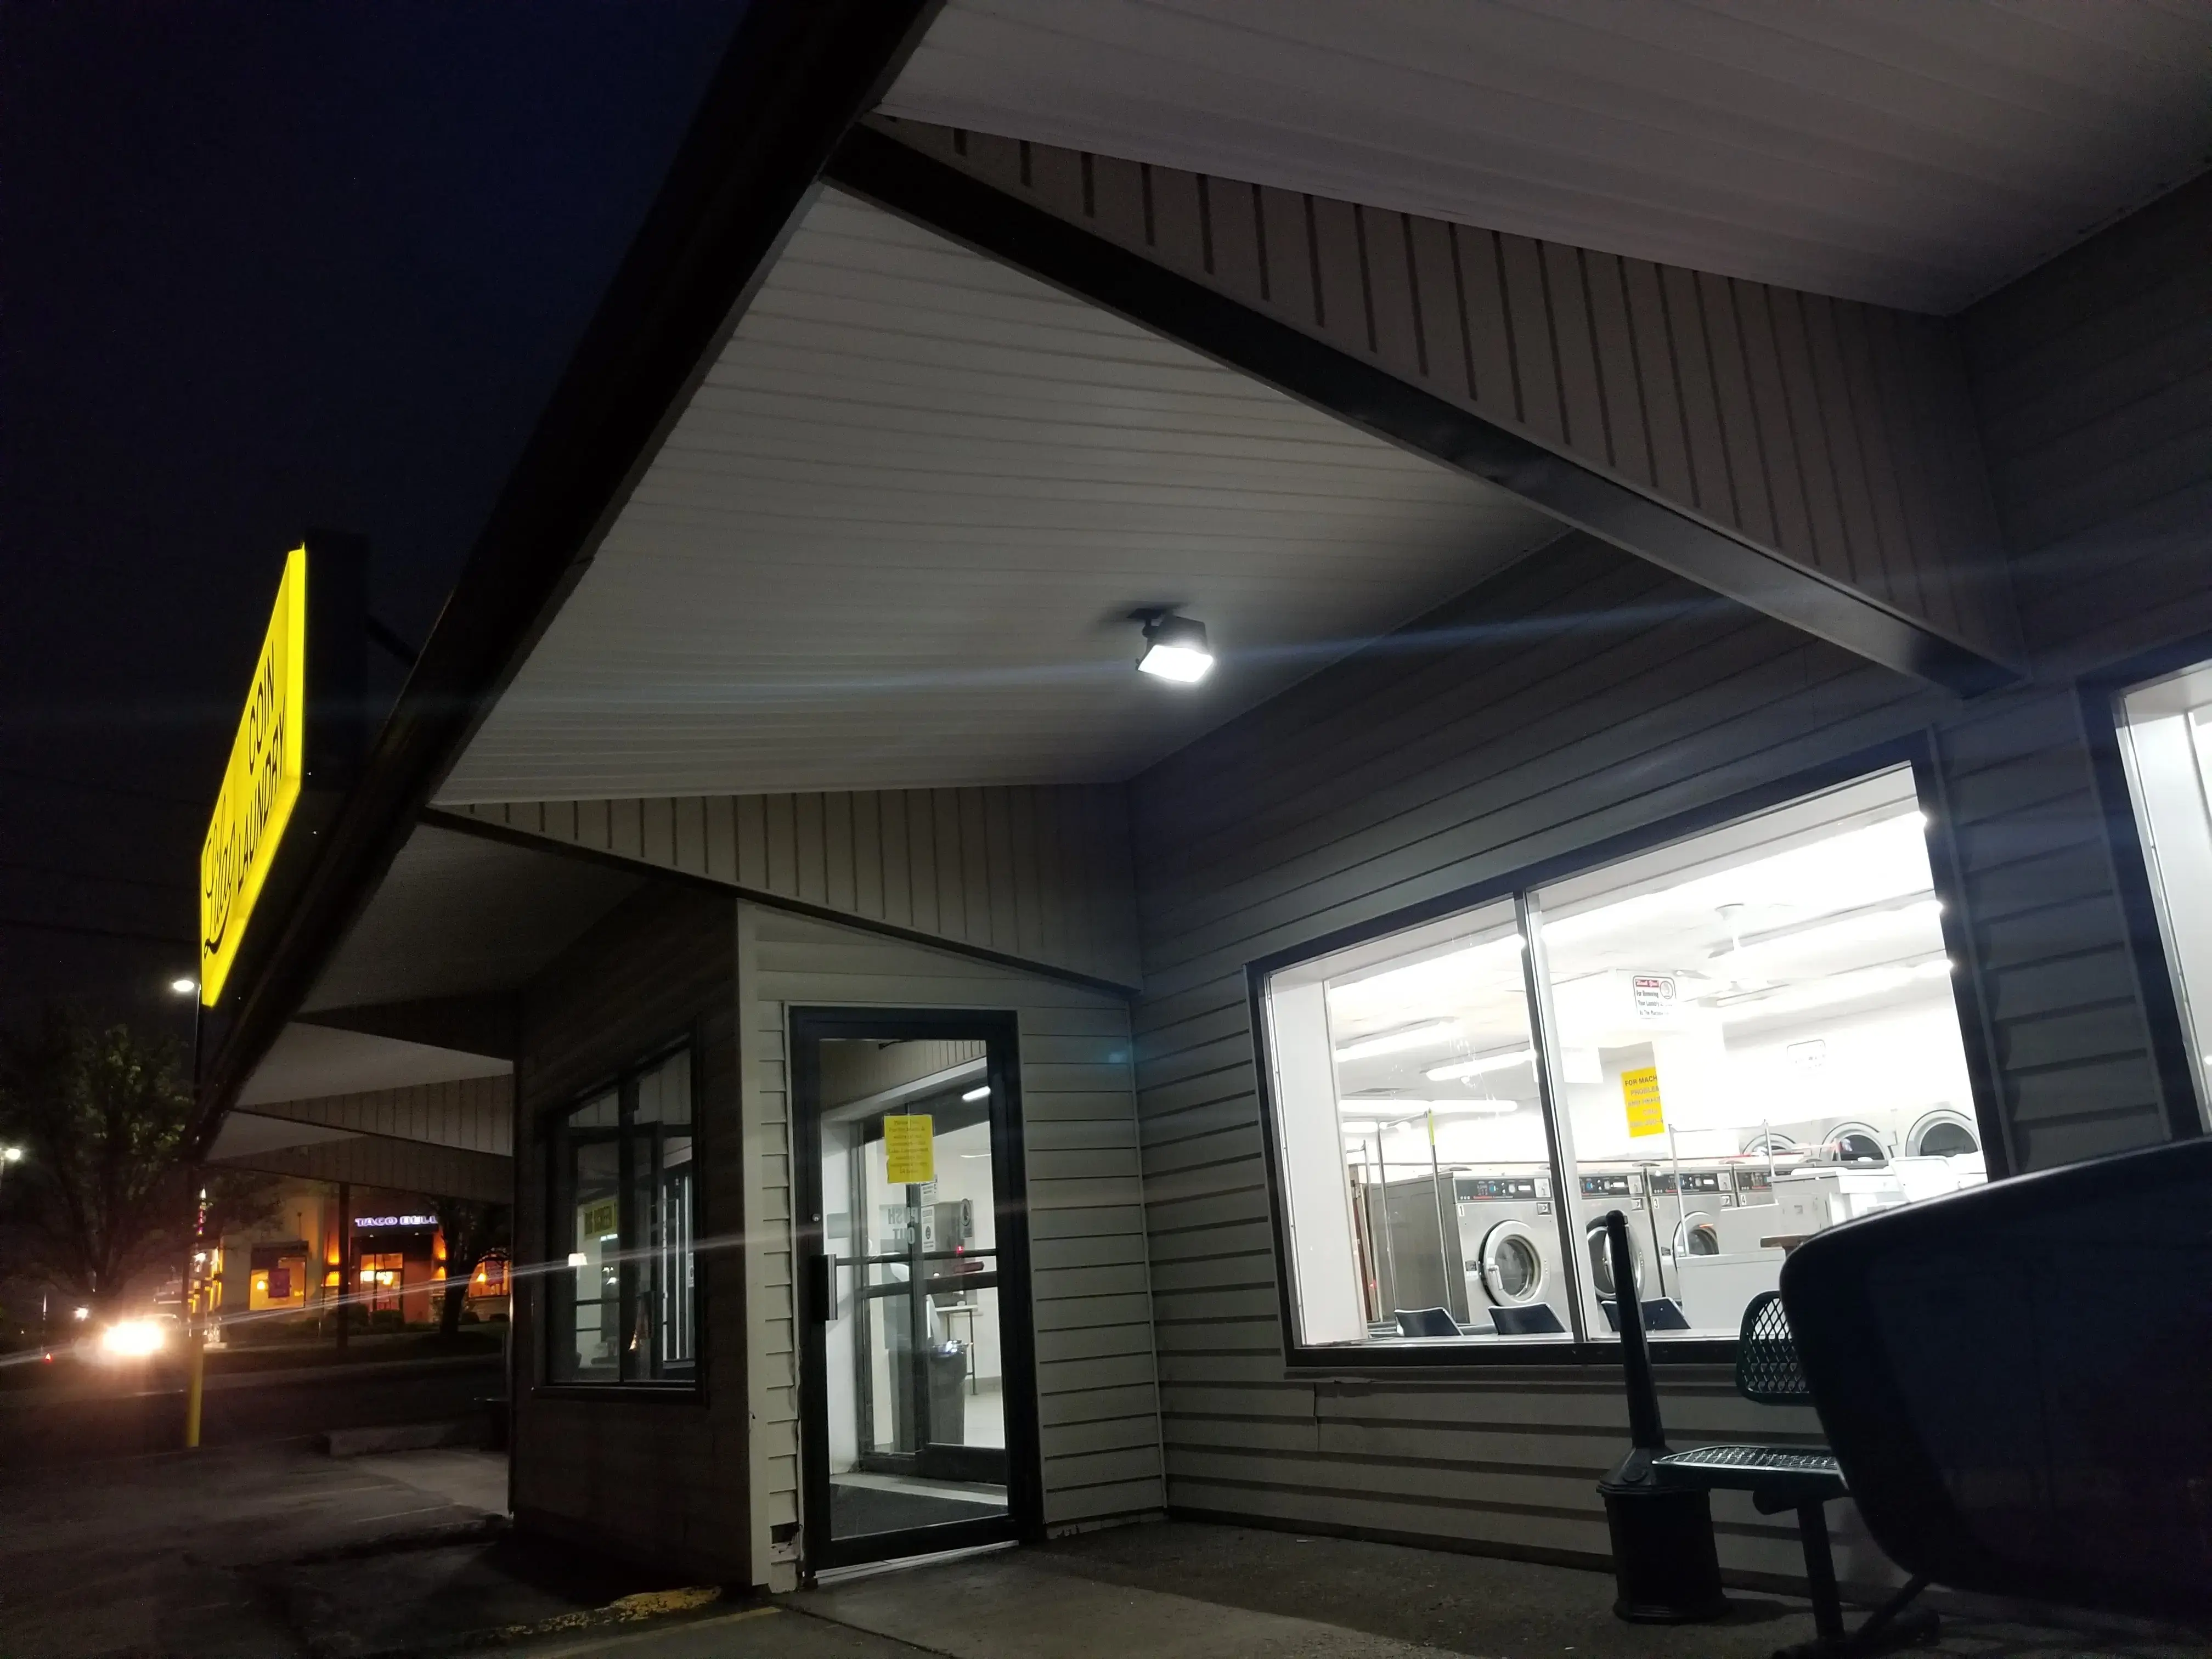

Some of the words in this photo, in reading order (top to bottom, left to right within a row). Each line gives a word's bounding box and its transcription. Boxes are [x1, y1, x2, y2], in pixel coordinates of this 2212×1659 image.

[249, 640, 274, 775] COIN
[238, 695, 286, 895] LAUNDRY
[204, 794, 236, 960] Lilac
[355, 1216, 398, 1227] TACO
